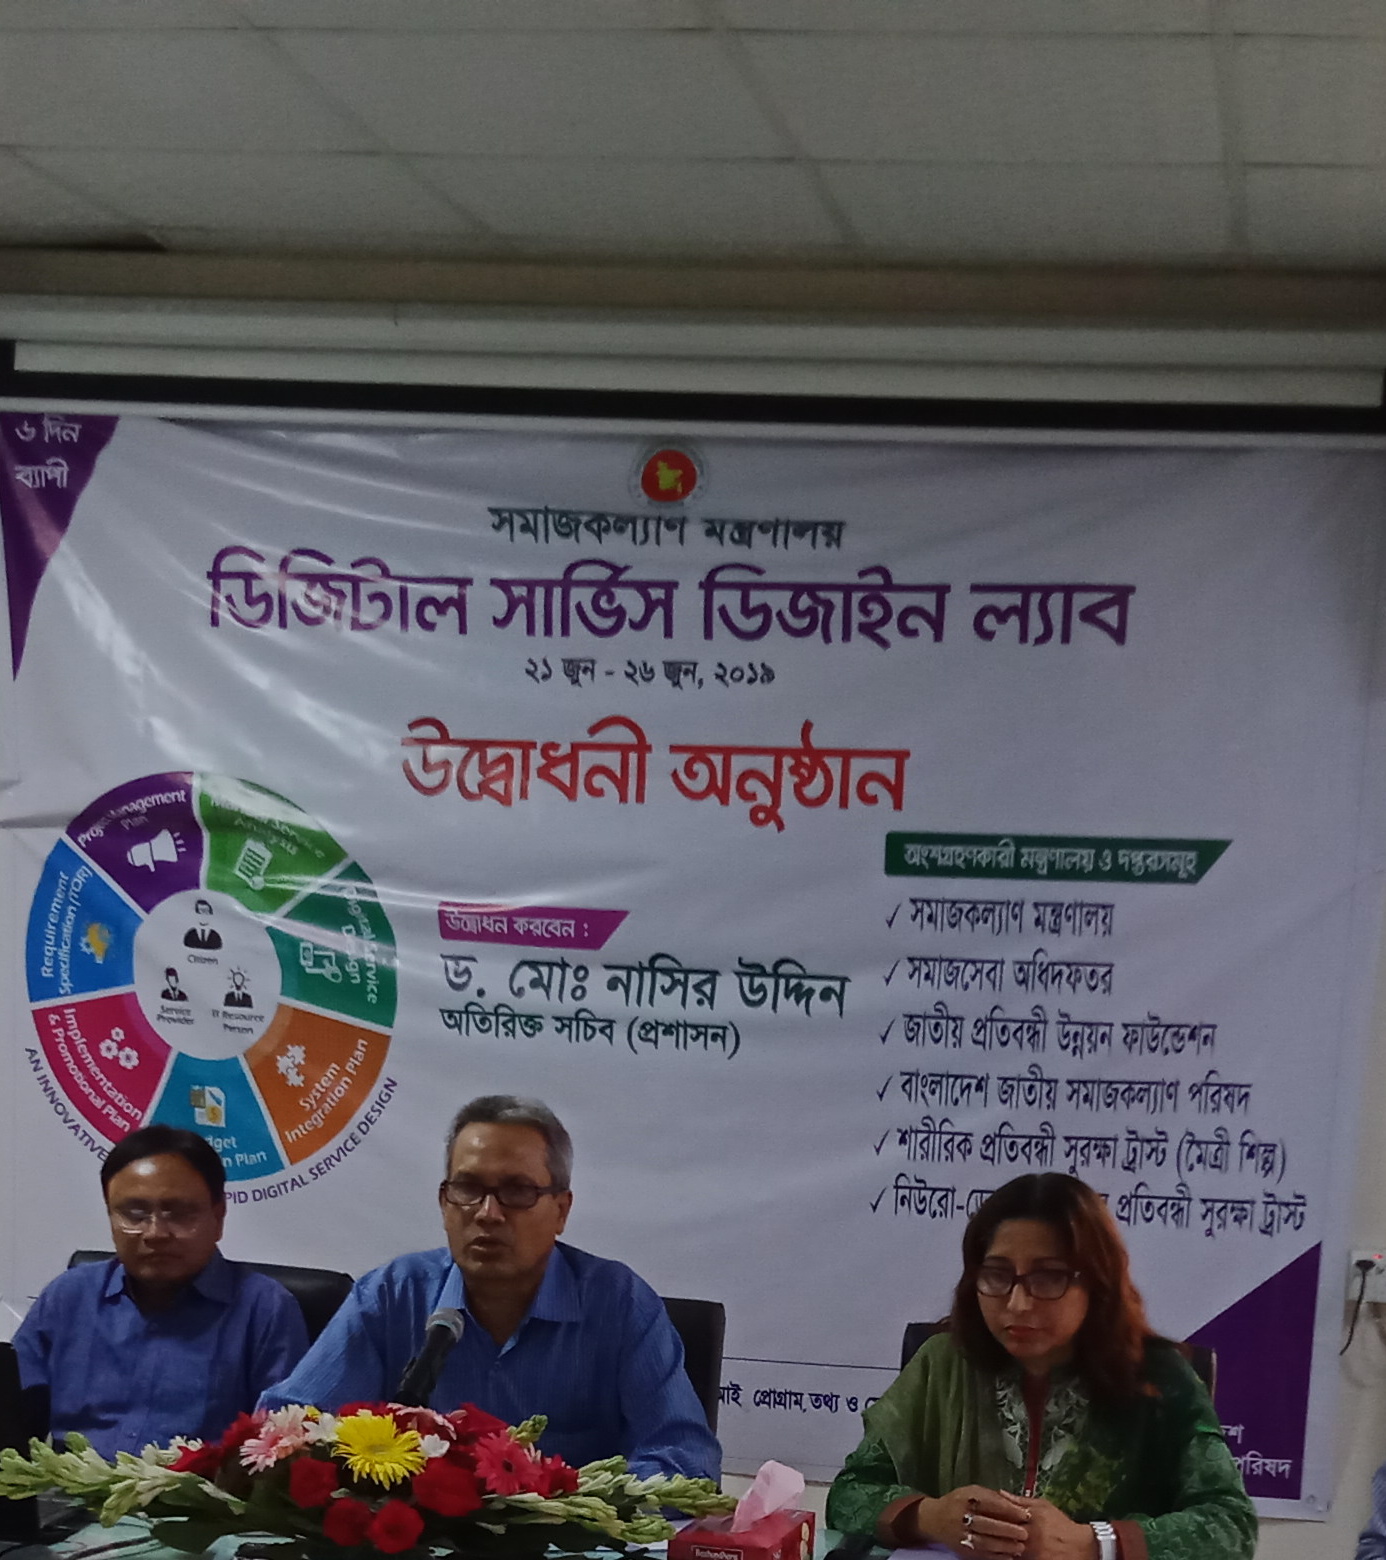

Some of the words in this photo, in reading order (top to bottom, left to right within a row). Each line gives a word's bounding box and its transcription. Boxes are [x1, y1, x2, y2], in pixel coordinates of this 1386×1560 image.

[14, 420, 37, 443] ৬
[42, 414, 82, 444] দিন
[13, 456, 70, 488] ব্যাপী
[489, 505, 687, 547] সমাজকল্যাণ
[704, 517, 846, 550] মন্ত্রণালয়
[206, 545, 472, 635] ডিজিটাল
[492, 557, 678, 640] সার্ভিস
[700, 563, 950, 650] ডিজাইন
[970, 583, 1136, 647] ল্যাব
[525, 657, 555, 686] ২১
[561, 657, 597, 689] জুন
[624, 657, 656, 686] ২৬
[663, 658, 705, 691] জুন,
[714, 661, 776, 688] ২০১৯
[401, 716, 652, 809] উদ্বোধনী
[670, 720, 911, 833] অনুষ্ঠান
[1099, 852, 1112, 872] ও
[41, 870, 70, 979] Requirement
[58, 905, 79, 996] Specification
[71, 864, 93, 910] (TOR)
[512, 917, 576, 939] করবেন
[910, 897, 1024, 937] সমাজকল্যাণ
[1034, 900, 1114, 938] মন্ত্রণালয়
[441, 954, 486, 997] ড.
[509, 957, 589, 1004] মোঃ
[604, 954, 720, 1011] নাসির
[735, 957, 851, 1017] উদ্দিন
[907, 955, 1005, 994] সমাজসেবা
[1013, 948, 1113, 995] অধিদফতর
[440, 1002, 544, 1038] অতিরিক্ত
[554, 1009, 616, 1046] সচিব
[627, 1016, 741, 1059] (প্রশাসন)
[903, 1002, 963, 1049] জাতীয়
[971, 1005, 1048, 1054] প্রতিবন্ধী
[1057, 1009, 1113, 1058] উন্নয়ন
[1123, 1012, 1217, 1057] ফাউন্ডেশন
[52, 1027, 106, 1111] Promotional
[104, 1105, 132, 1133] Plan
[64, 1007, 144, 1120] Implementation
[284, 1078, 349, 1145] Integration
[341, 1038, 370, 1085] Plan
[299, 1061, 341, 1111] System
[901, 1070, 988, 1109] বাংলাদেশ
[997, 1065, 1058, 1111] জাতীয়
[1067, 1079, 1180, 1115] সমাজকল্যাণ
[1188, 1070, 1252, 1115] পরিষদ
[25, 1047, 44, 1074] AN
[35, 1076, 109, 1162] INNOVATIVE
[252, 1174, 310, 1202] DIGITAL
[308, 1135, 358, 1180] SERVICE
[355, 1077, 399, 1138] DESIGN
[898, 1116, 973, 1161] শারীরিক
[981, 1122, 1055, 1168] প্রতিবন্ধী
[1064, 1132, 1117, 1175] সুরক্ষা
[1122, 1128, 1168, 1172] ট্রাস্ট
[1177, 1128, 1229, 1180] (মৈত্রী
[1239, 1131, 1287, 1182] শিল্প)
[1117, 1182, 1192, 1228] প্রতিবন্ধী
[1201, 1194, 1254, 1237] সুরক্ষা
[1260, 1186, 1307, 1236] ট্রাস্ট
[808, 1392, 841, 1413] তথ্য
[846, 1396, 859, 1413] ও
